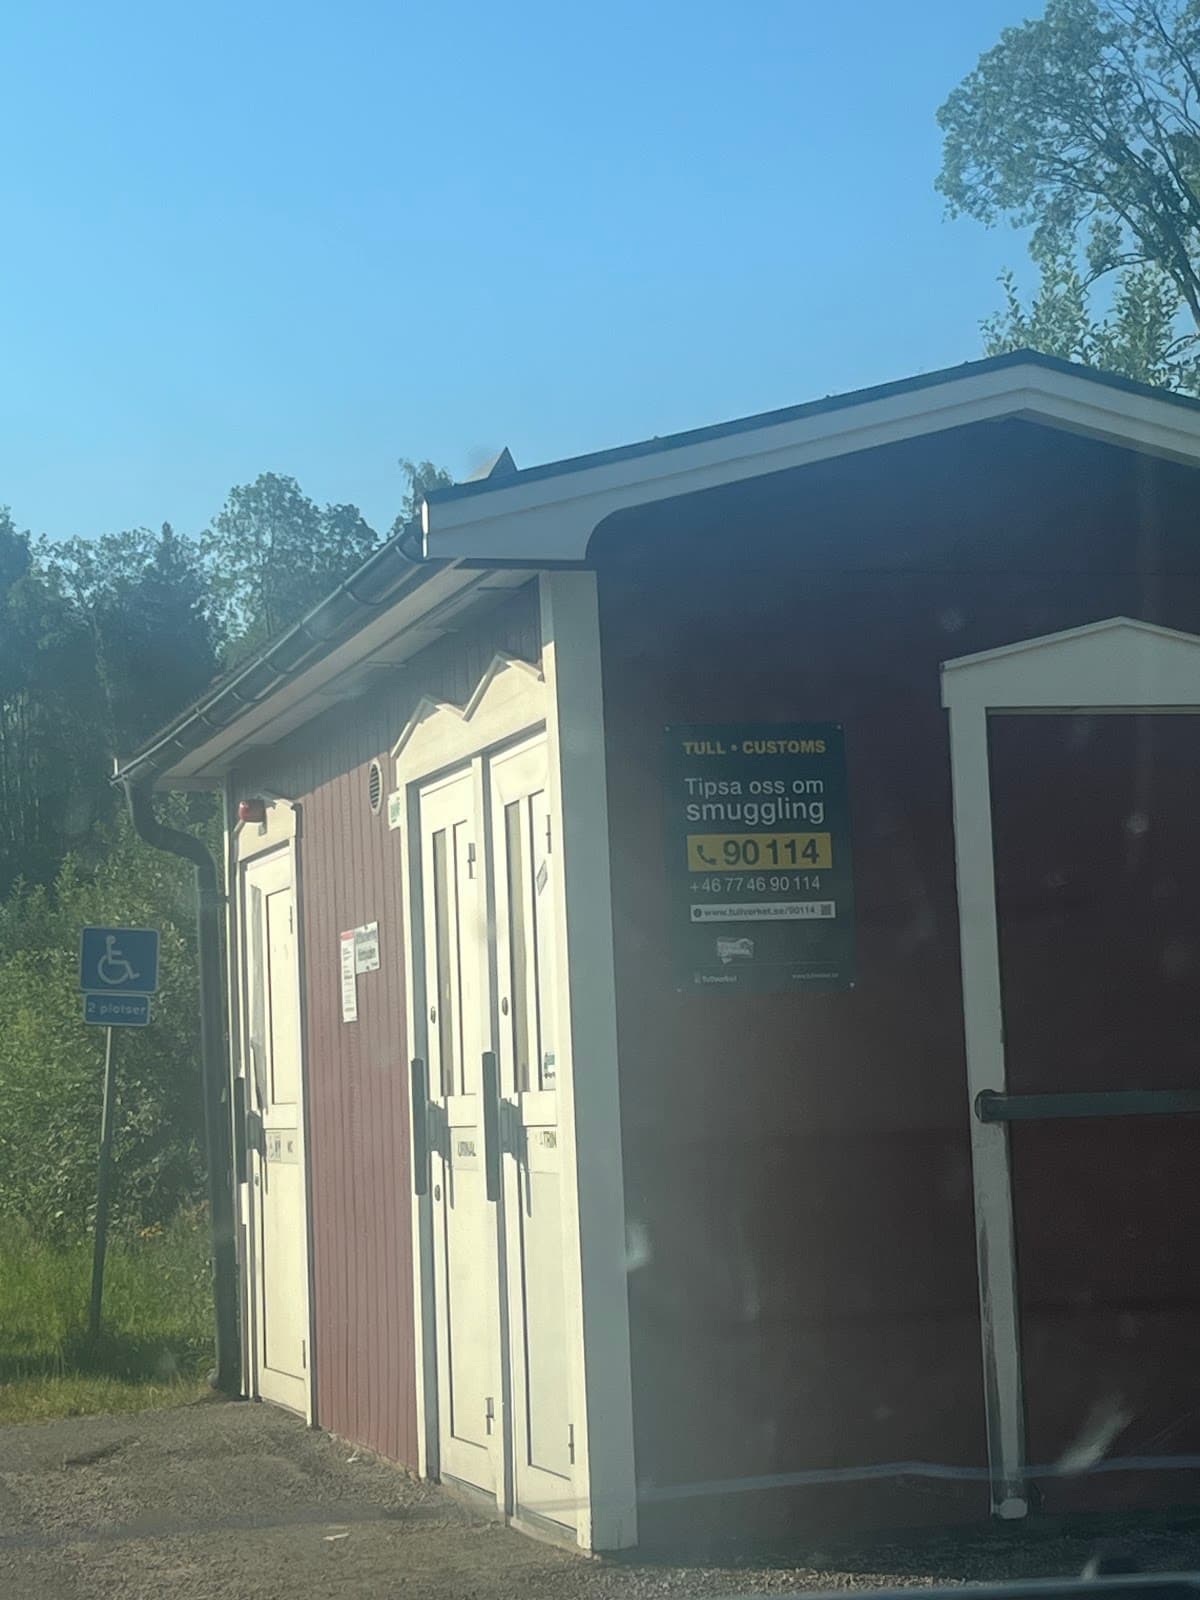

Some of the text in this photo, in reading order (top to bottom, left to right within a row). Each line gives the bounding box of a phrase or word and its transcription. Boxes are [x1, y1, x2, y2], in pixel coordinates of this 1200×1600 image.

[682, 740, 826, 755] TULL CUSTOMS
[684, 777, 824, 799] Tipsa oss om
[686, 797, 824, 825] smuggling
[690, 877, 721, 892] +46
[747, 876, 767, 891] 46
[770, 876, 790, 891] 90
[794, 875, 820, 891] 114
[87, 1001, 96, 1013] 2
